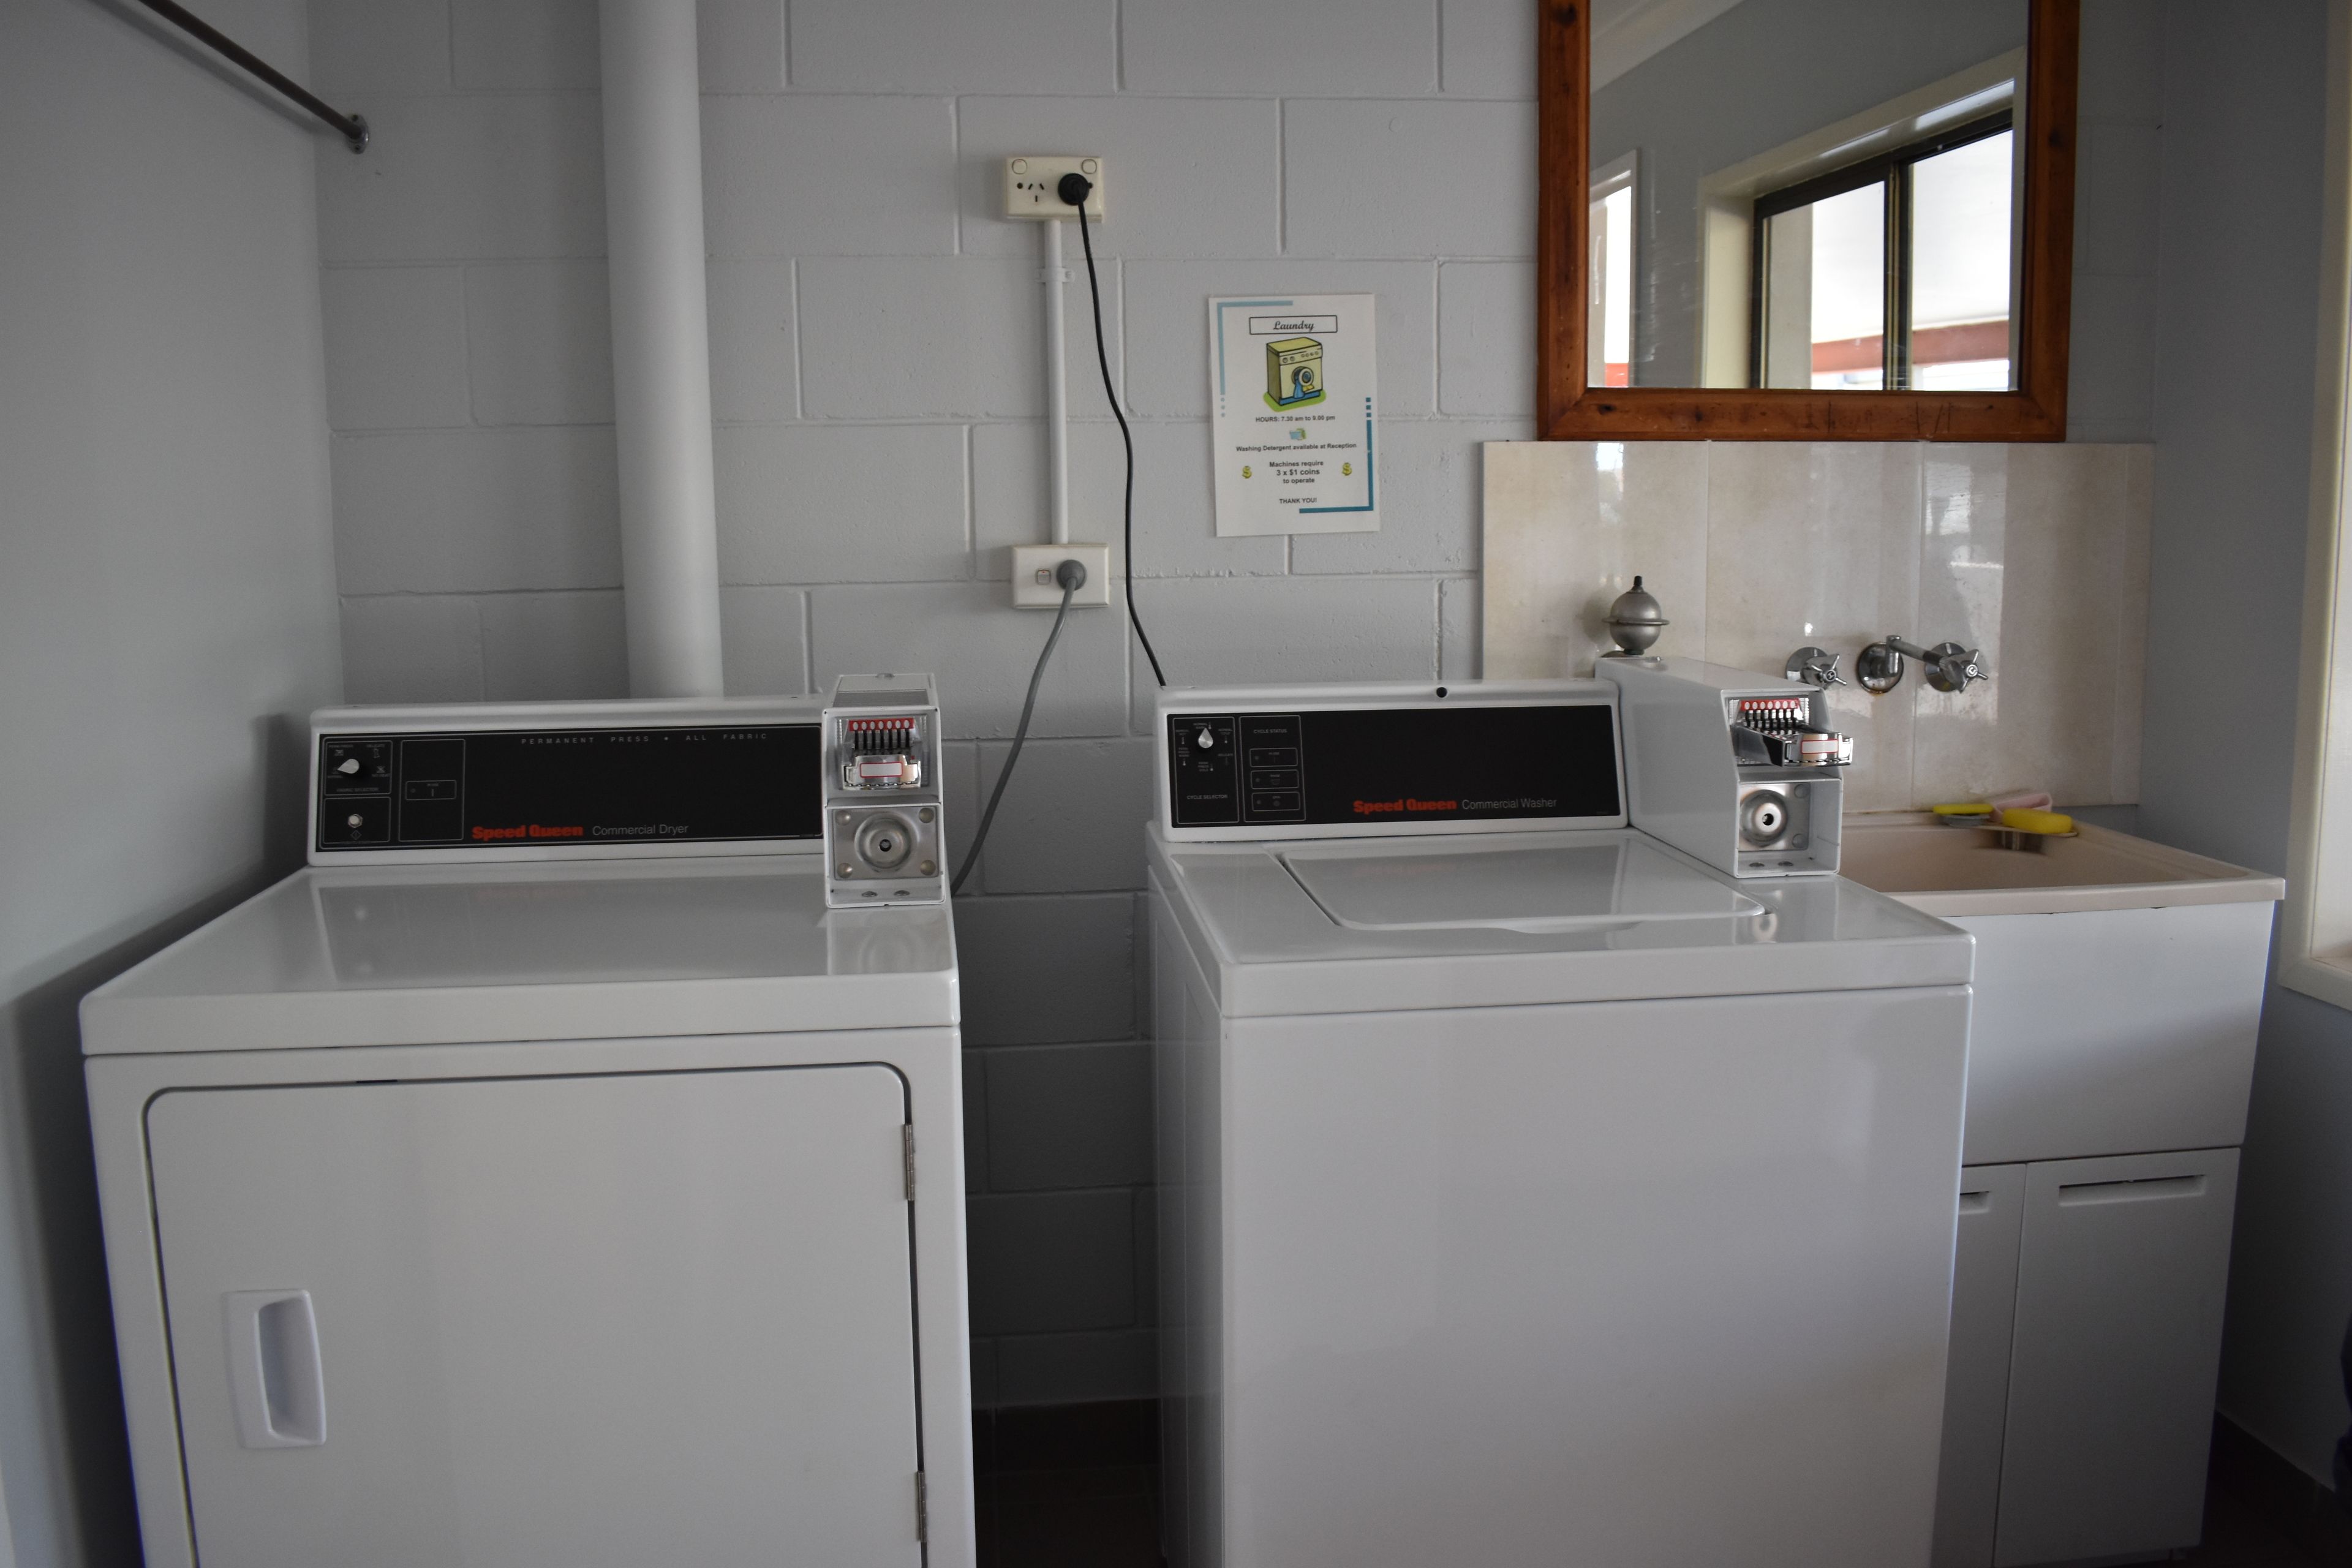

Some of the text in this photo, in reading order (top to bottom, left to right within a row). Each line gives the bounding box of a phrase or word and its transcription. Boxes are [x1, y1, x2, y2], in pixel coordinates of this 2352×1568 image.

[1273, 320, 1314, 332] Laundry
[521, 736, 595, 745] PERMANENT
[1353, 797, 1557, 815] Speed Queen Commercial Washer
[472, 824, 689, 842] Speed Queen Commercial Dryer
